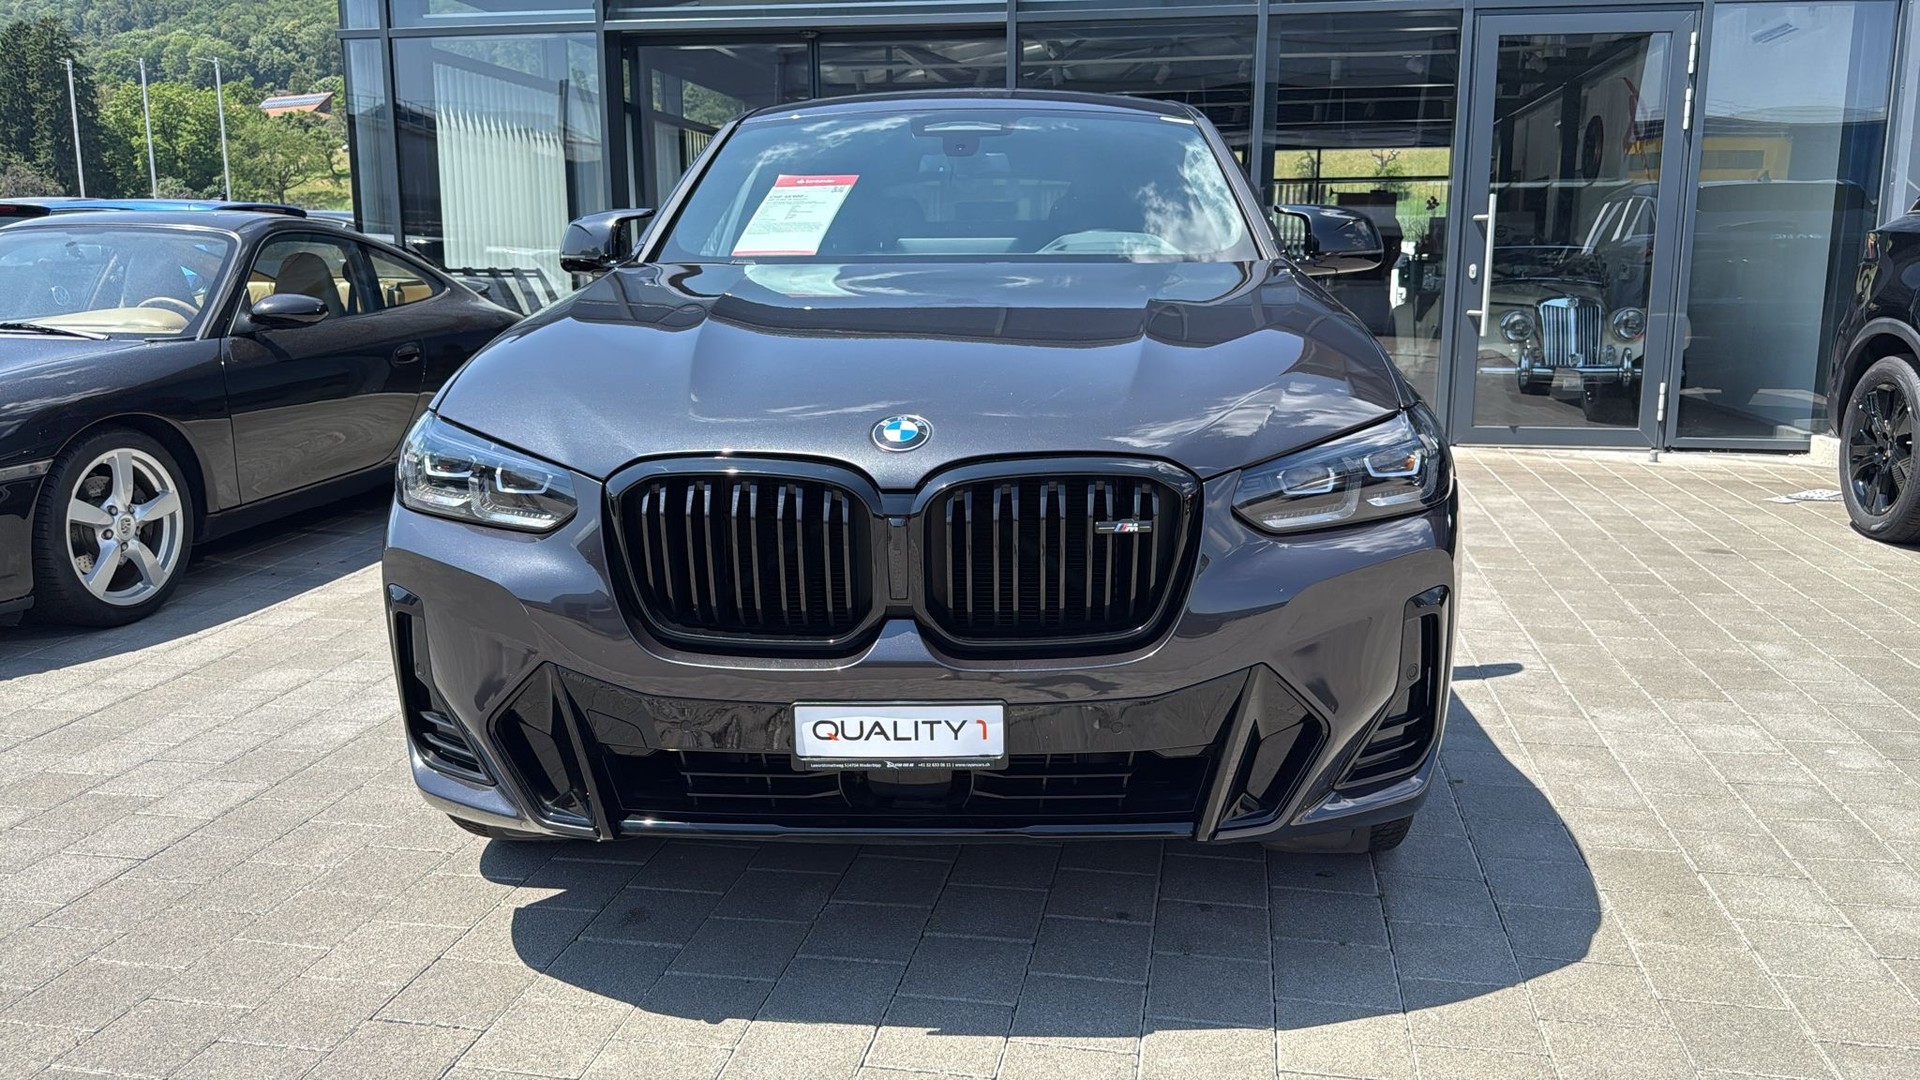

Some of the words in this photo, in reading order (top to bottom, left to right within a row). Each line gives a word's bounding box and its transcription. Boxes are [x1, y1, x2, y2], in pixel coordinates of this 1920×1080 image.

[879, 416, 924, 427] BMW
[812, 719, 968, 742] QUALITY
[976, 719, 988, 741] 1
